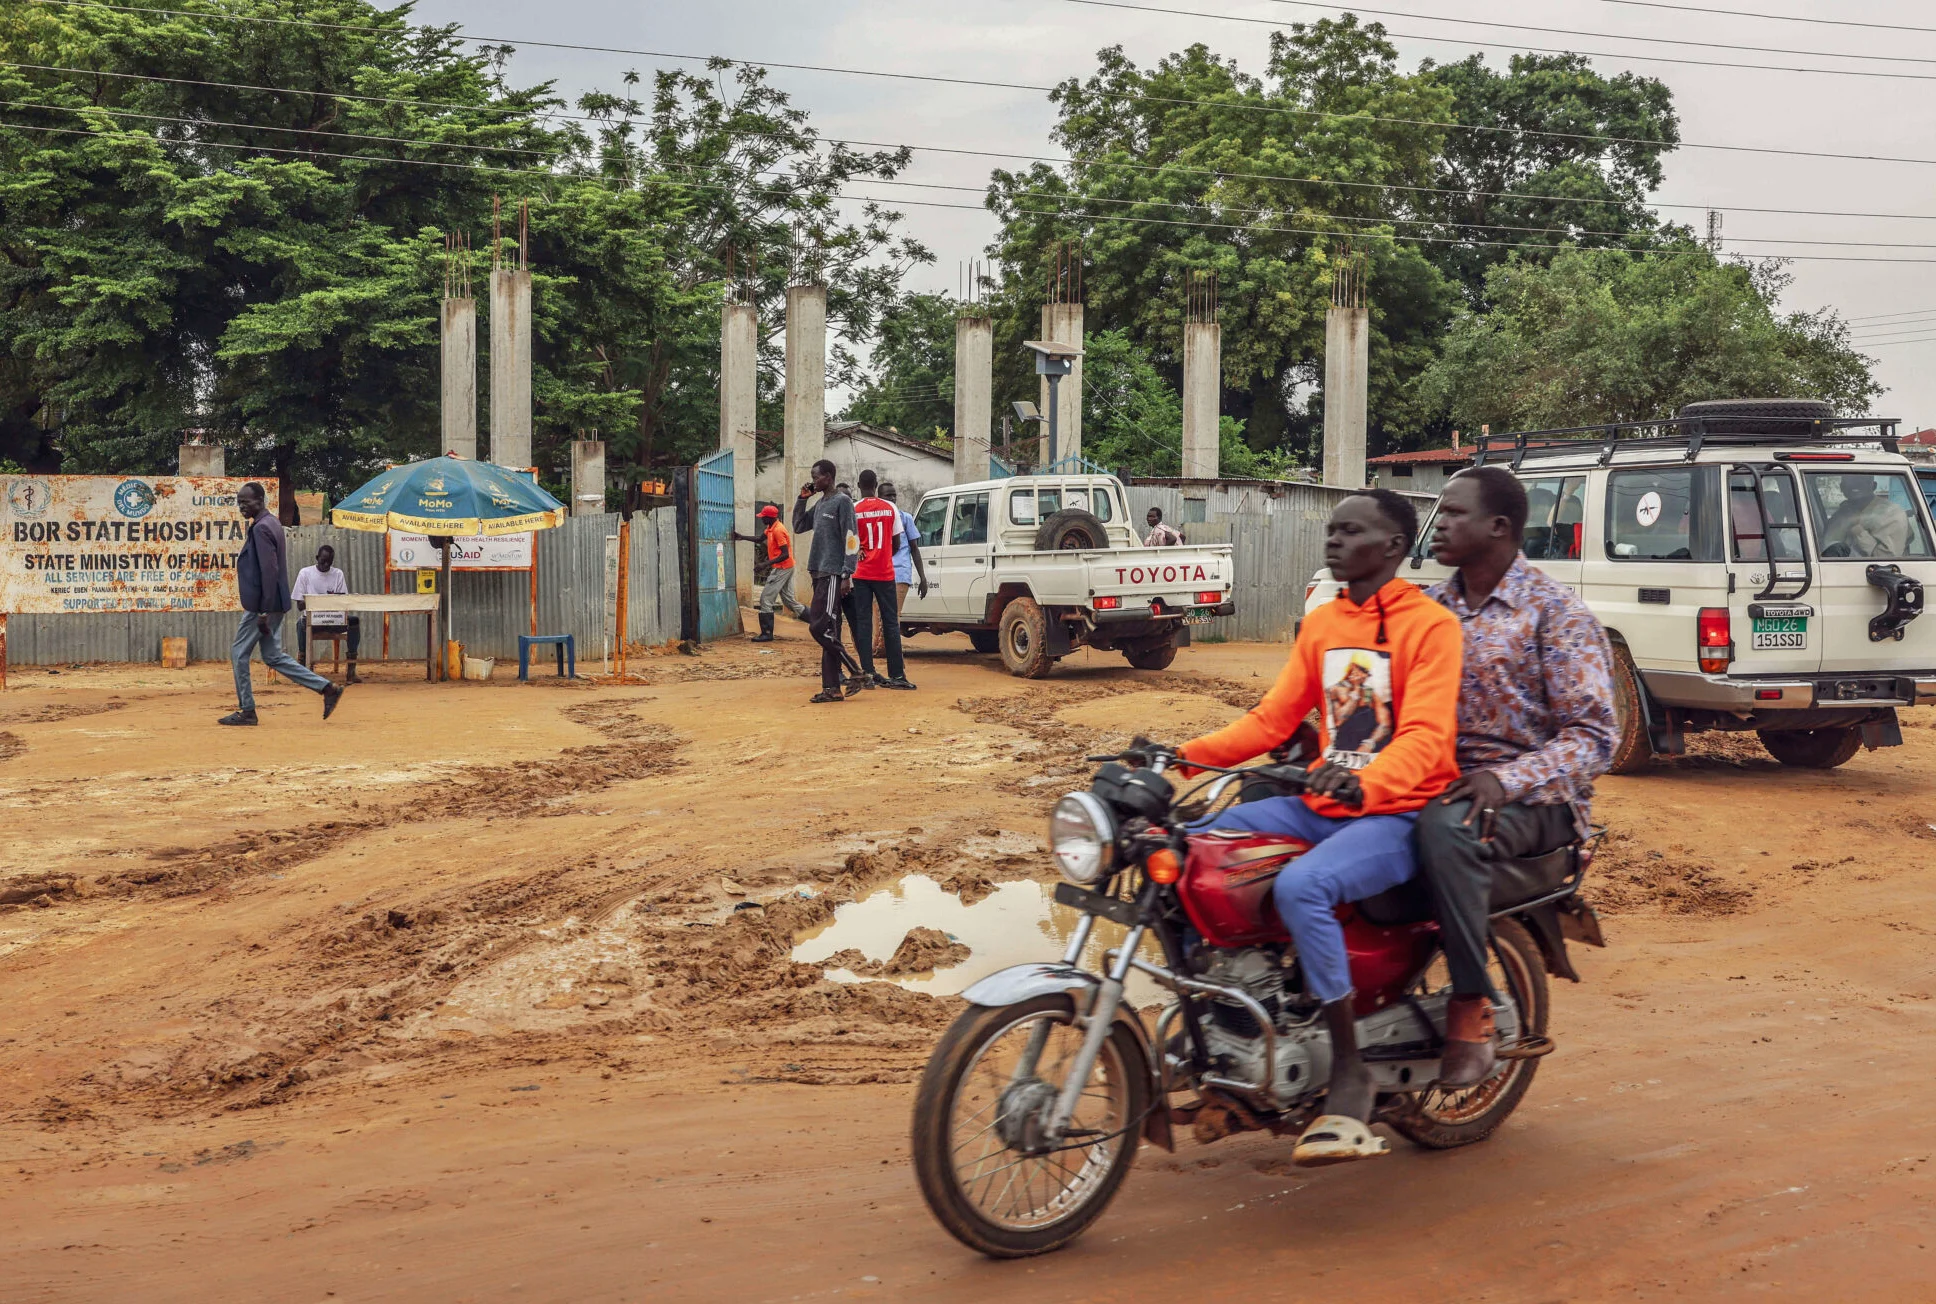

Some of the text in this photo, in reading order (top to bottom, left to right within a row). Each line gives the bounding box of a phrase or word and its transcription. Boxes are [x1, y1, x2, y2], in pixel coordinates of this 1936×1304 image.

[192, 495, 240, 507] unice
[418, 498, 453, 509] MoMo
[116, 499, 150, 517] DEL MUNDO
[341, 515, 368, 524] AVAILABLE
[399, 518, 441, 528] AVAILABLE
[488, 515, 544, 530] AVAILABLE HERE
[14, 521, 61, 542] BOR
[66, 521, 141, 542] STATE
[866, 521, 884, 550] 11
[24, 552, 239, 570] STATE MINISTRY OF HEALT
[450, 551, 481, 559] USAID
[45, 570, 221, 583] ALL SERVICES ARE FREE OF CHARGE
[1115, 564, 1207, 585] TOYOTA
[63, 598, 117, 610] SUPPORTED
[170, 598, 194, 609] BANK
[1766, 609, 1793, 617] TOYOTA
[1756, 618, 1798, 632] NGO 26
[1757, 633, 1803, 647] 151SSD
